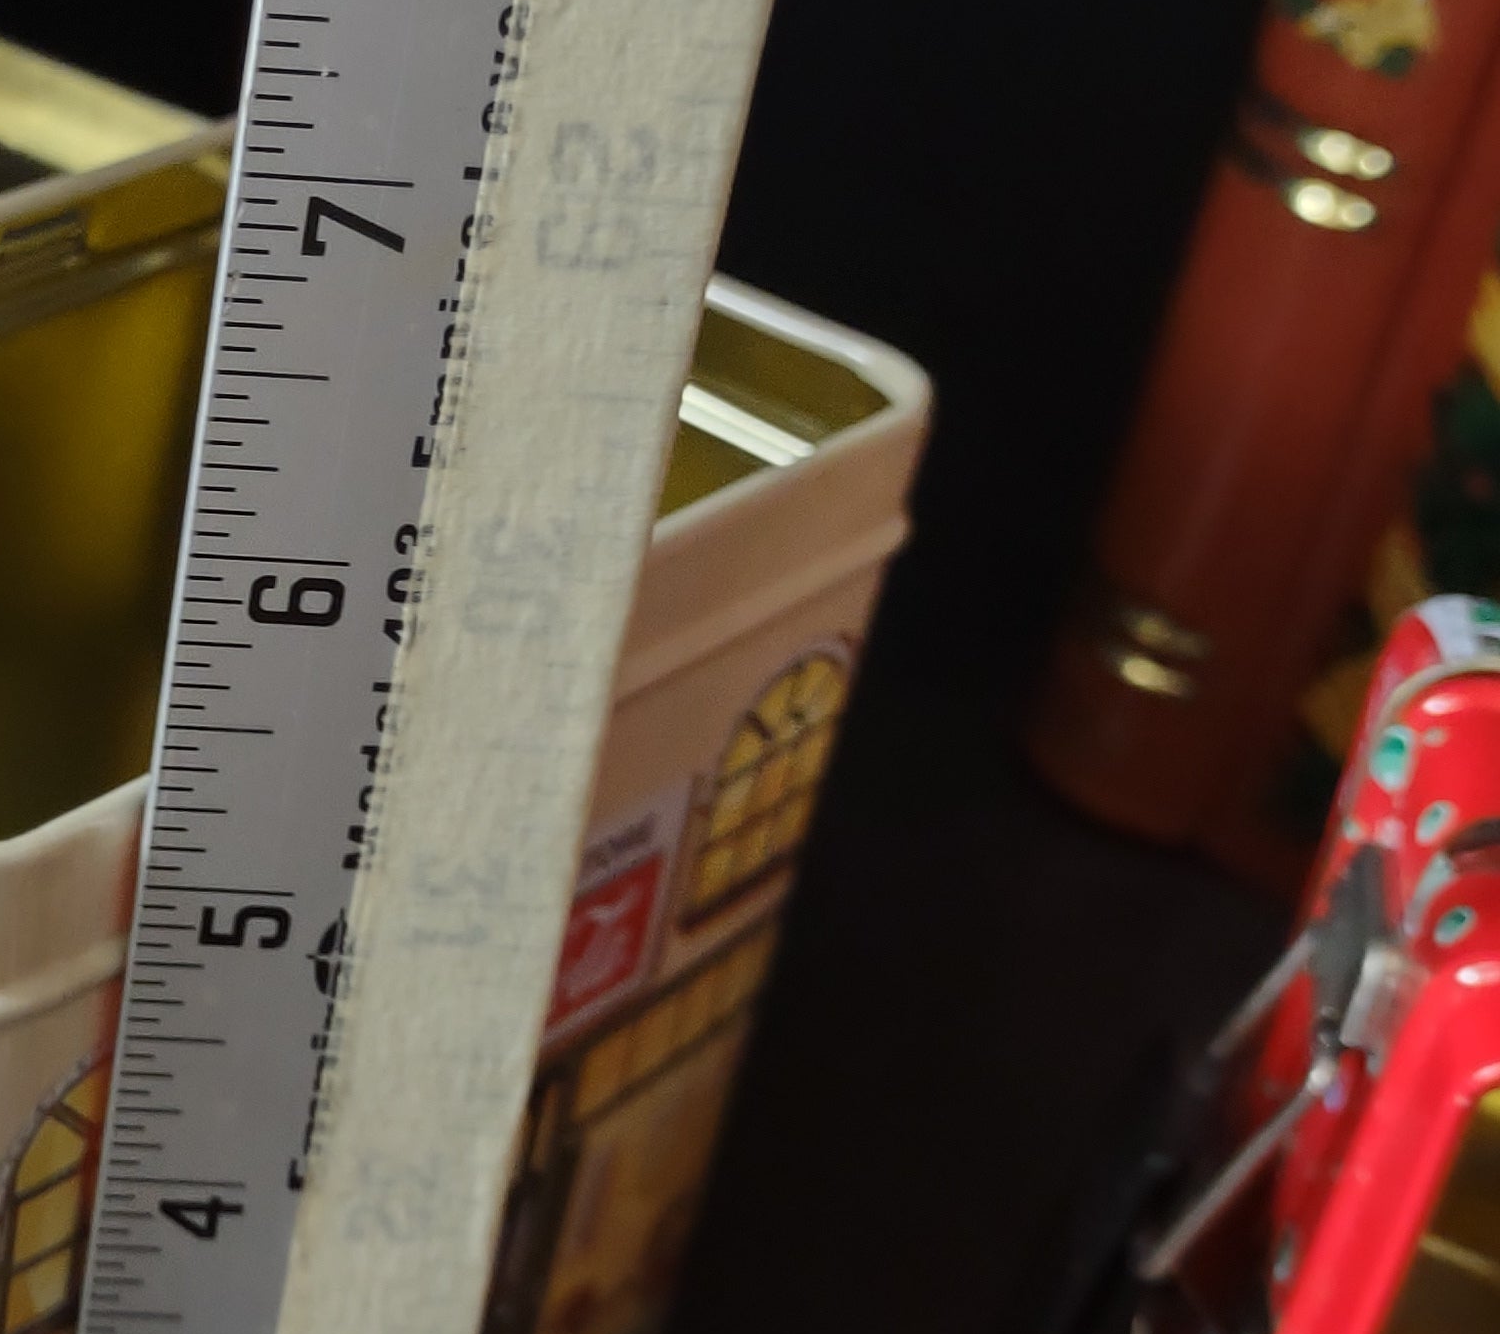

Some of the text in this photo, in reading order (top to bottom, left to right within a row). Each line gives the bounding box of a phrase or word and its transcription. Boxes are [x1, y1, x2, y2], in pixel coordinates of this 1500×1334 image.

[300, 194, 406, 258] 7
[247, 574, 346, 628] 6
[200, 903, 293, 952] 5
[158, 1195, 245, 1240] 4
